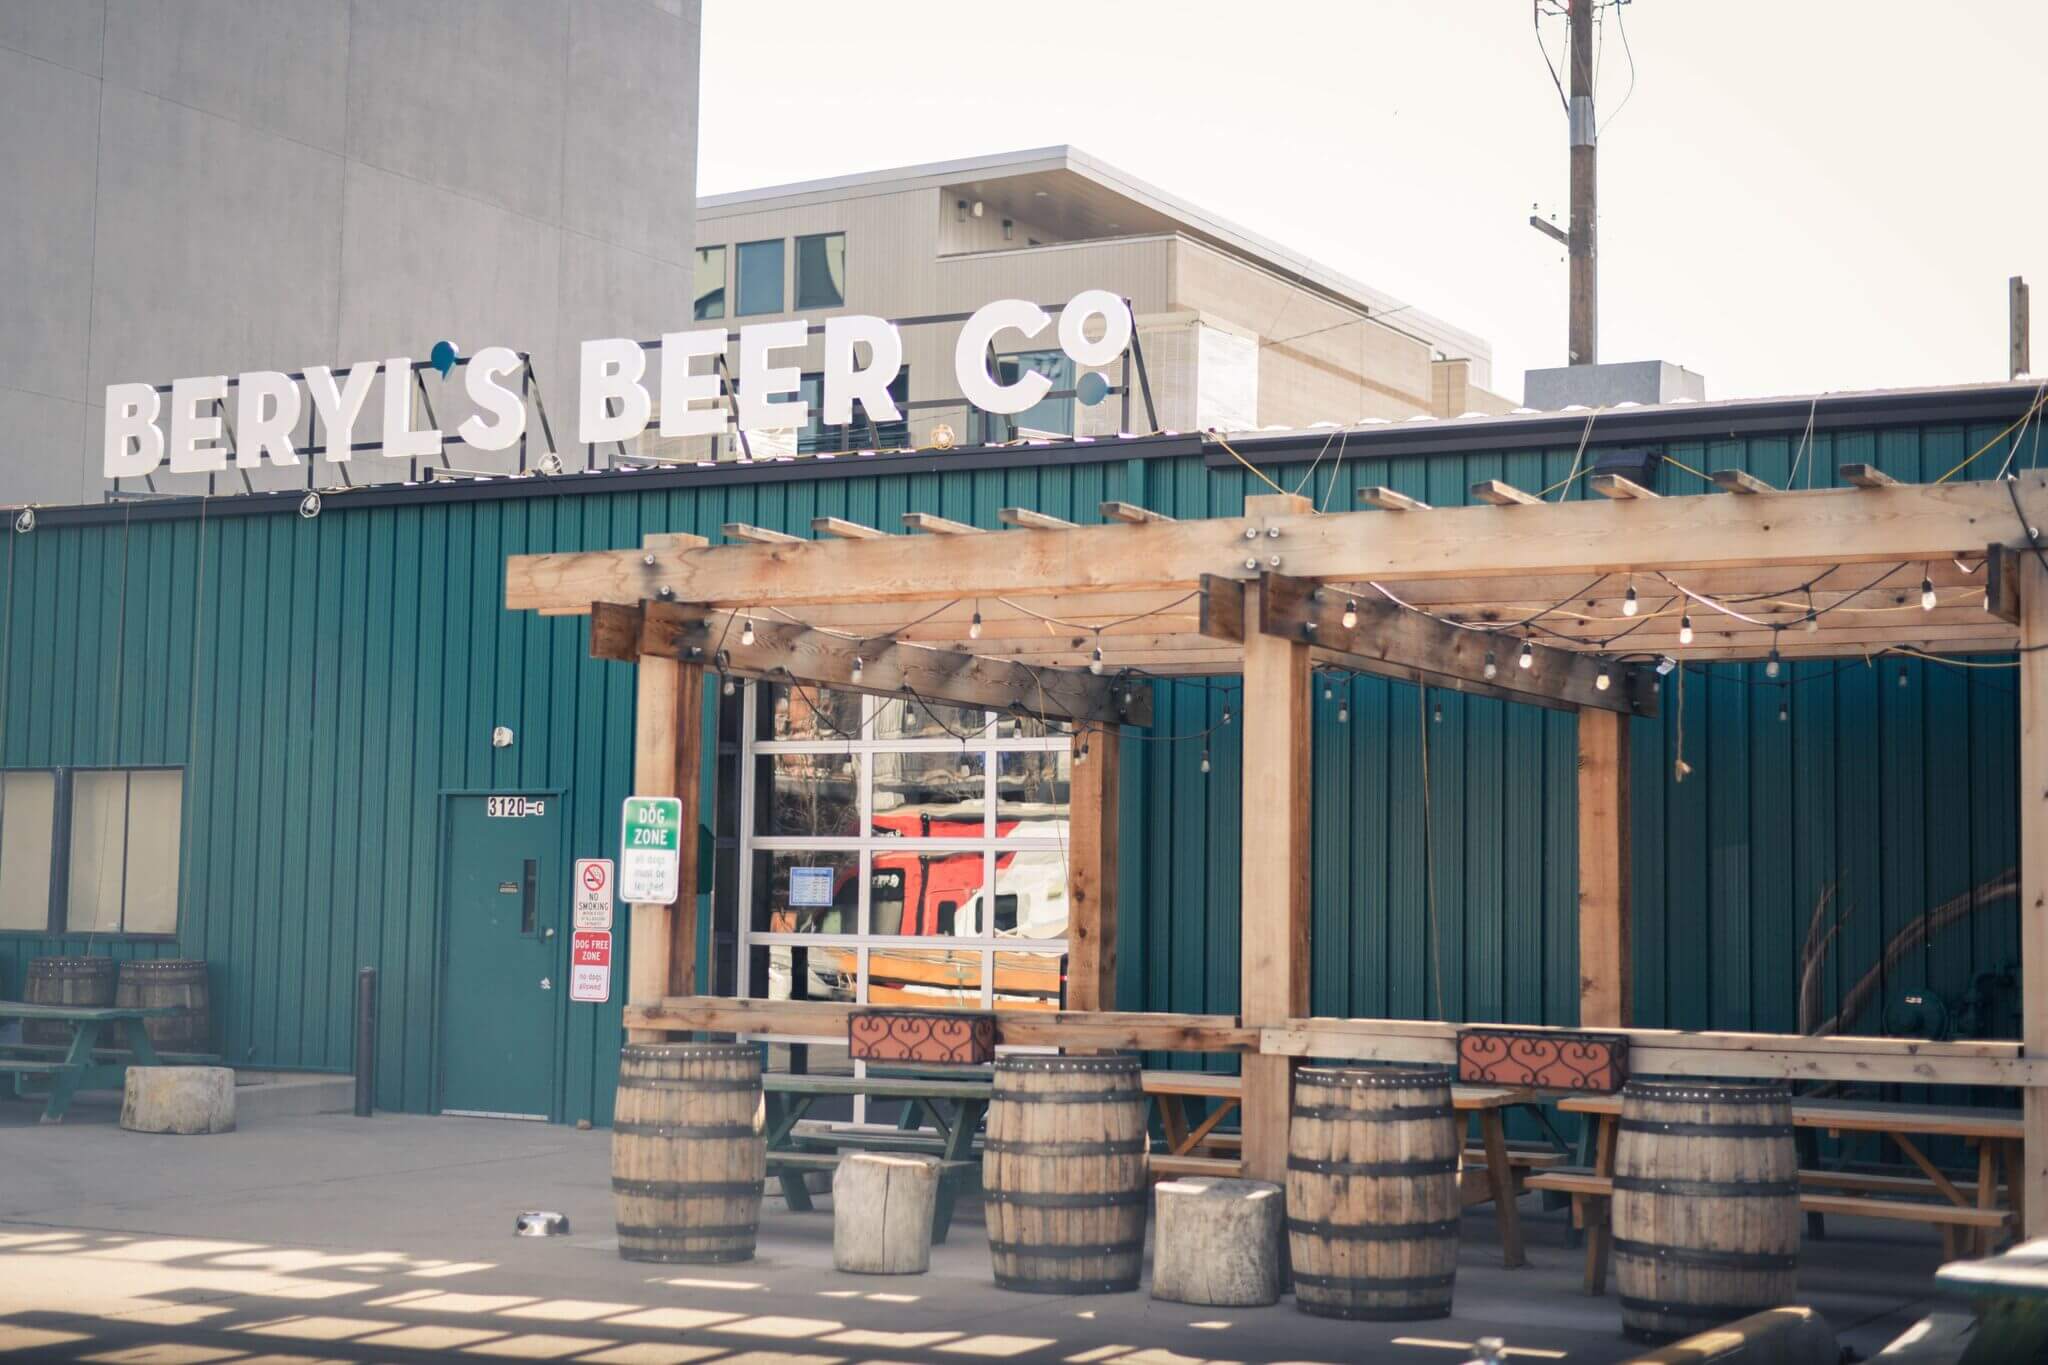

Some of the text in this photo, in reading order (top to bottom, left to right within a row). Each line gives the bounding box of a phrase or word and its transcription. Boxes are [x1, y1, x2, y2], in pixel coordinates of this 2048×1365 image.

[104, 341, 526, 478] BERYL'S
[579, 315, 902, 443] BEER
[489, 797, 544, 817] 3120-C
[639, 808, 665, 824] DOG
[634, 828, 668, 845] ZONE
[589, 892, 599, 901] NO
[578, 902, 609, 911] SMOKING
[575, 939, 609, 950] DOG FREE
[582, 951, 601, 961] ZONE
